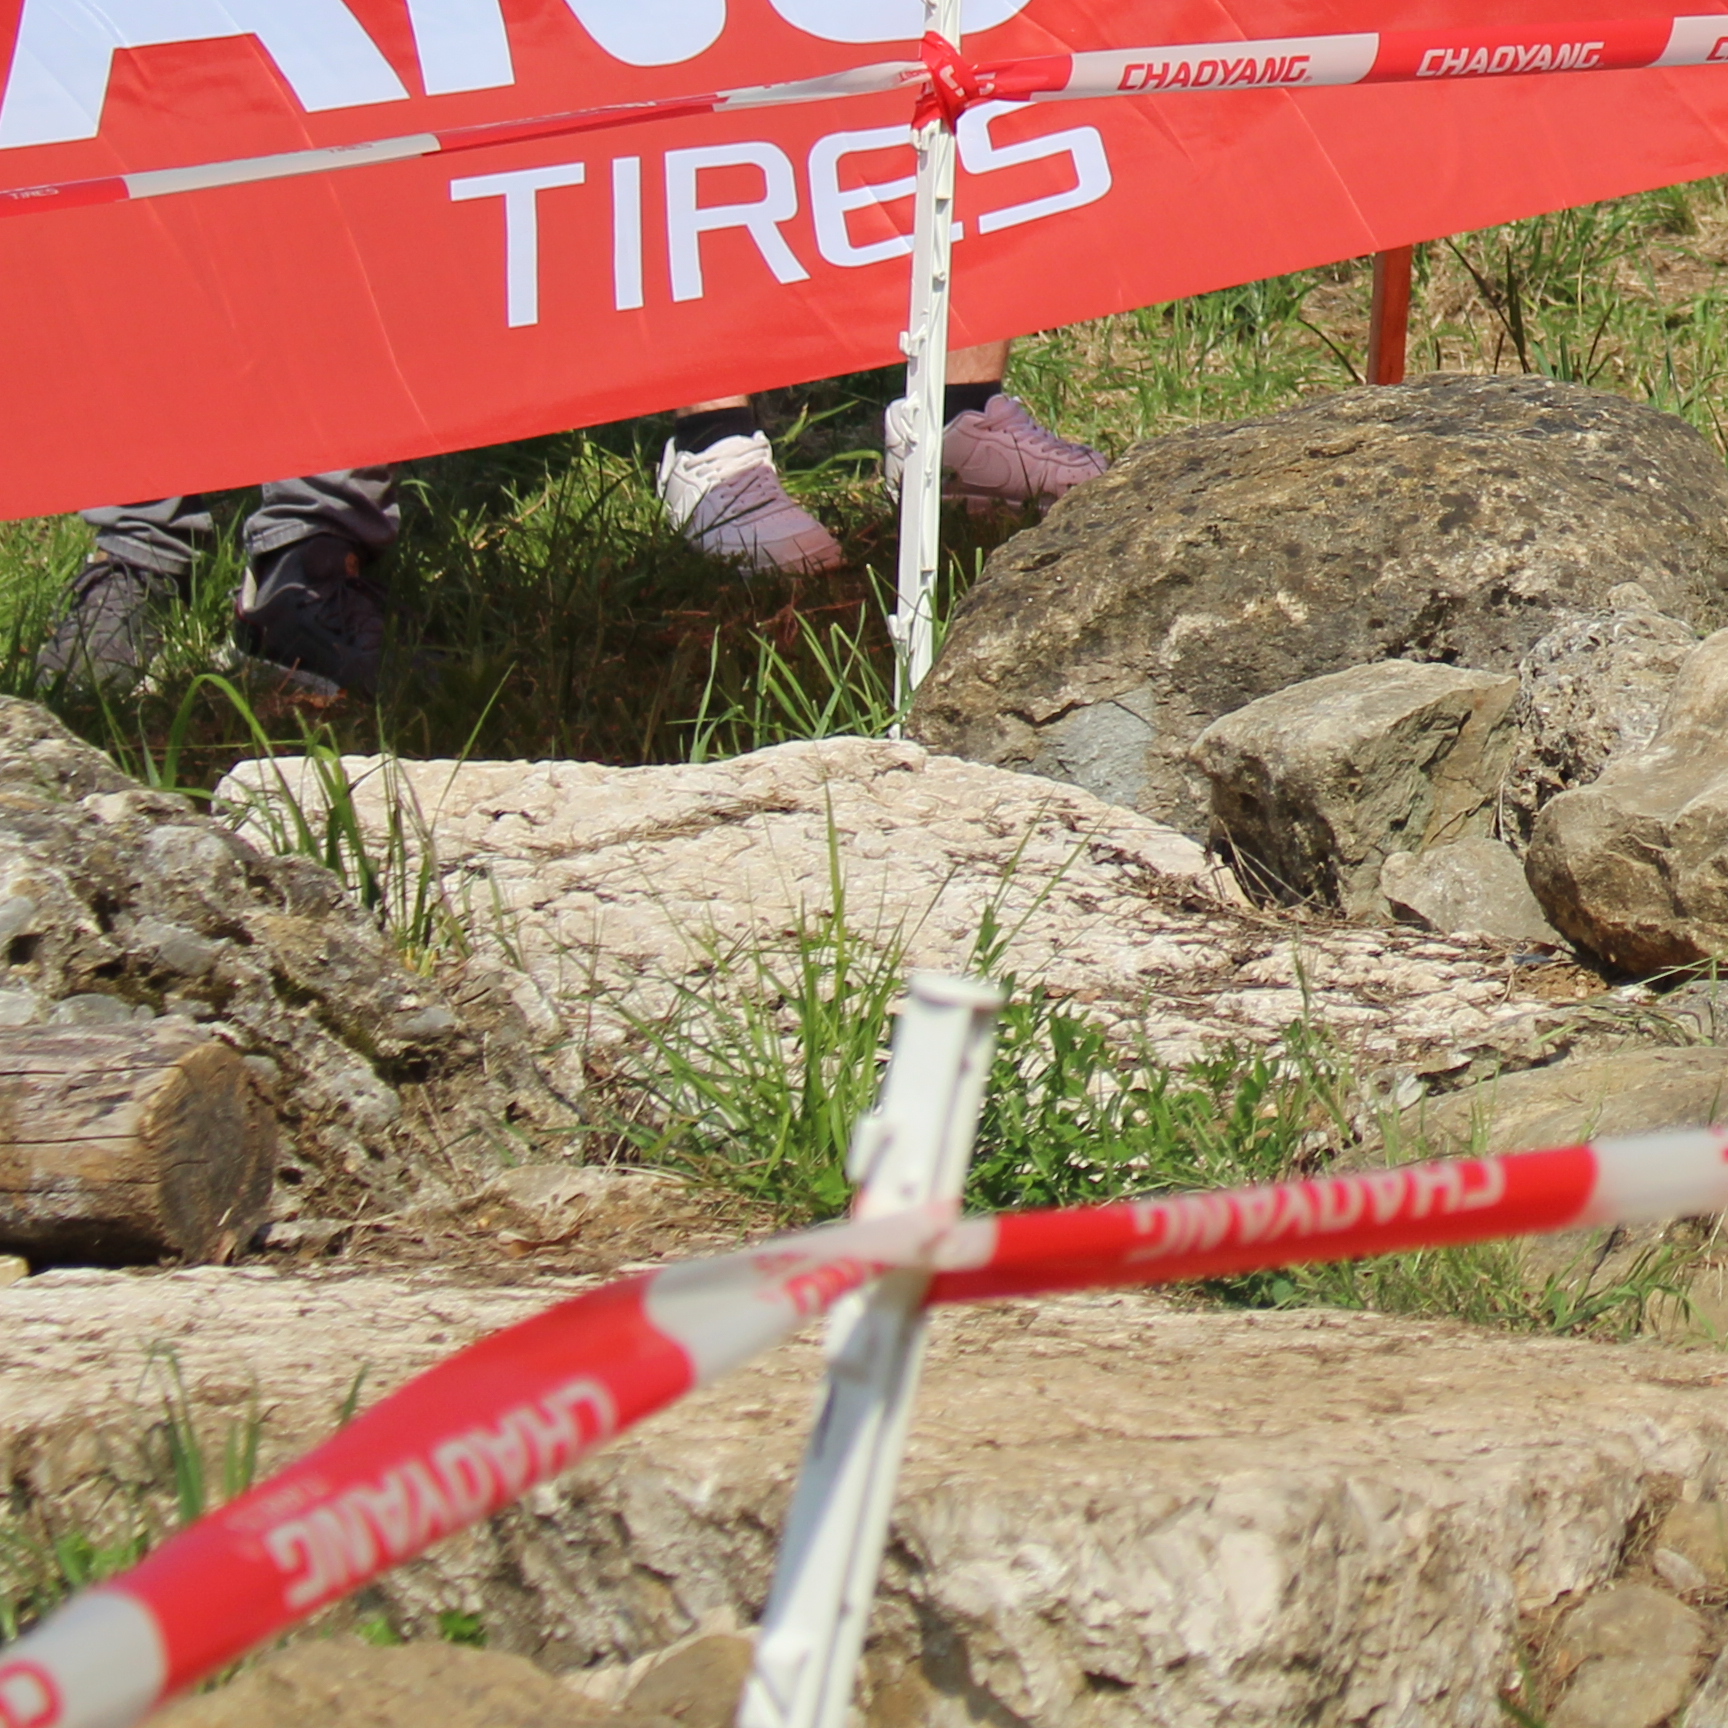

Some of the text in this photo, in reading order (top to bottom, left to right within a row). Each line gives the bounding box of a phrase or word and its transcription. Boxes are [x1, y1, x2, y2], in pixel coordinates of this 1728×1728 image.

[1117, 55, 1313, 92] CHAOYANG
[1415, 41, 1606, 79] CHAOYANG
[450, 101, 1113, 330] TIRES
[1123, 1154, 1507, 1264] CHAOYANG
[265, 1375, 615, 1610] CHAOYANG
